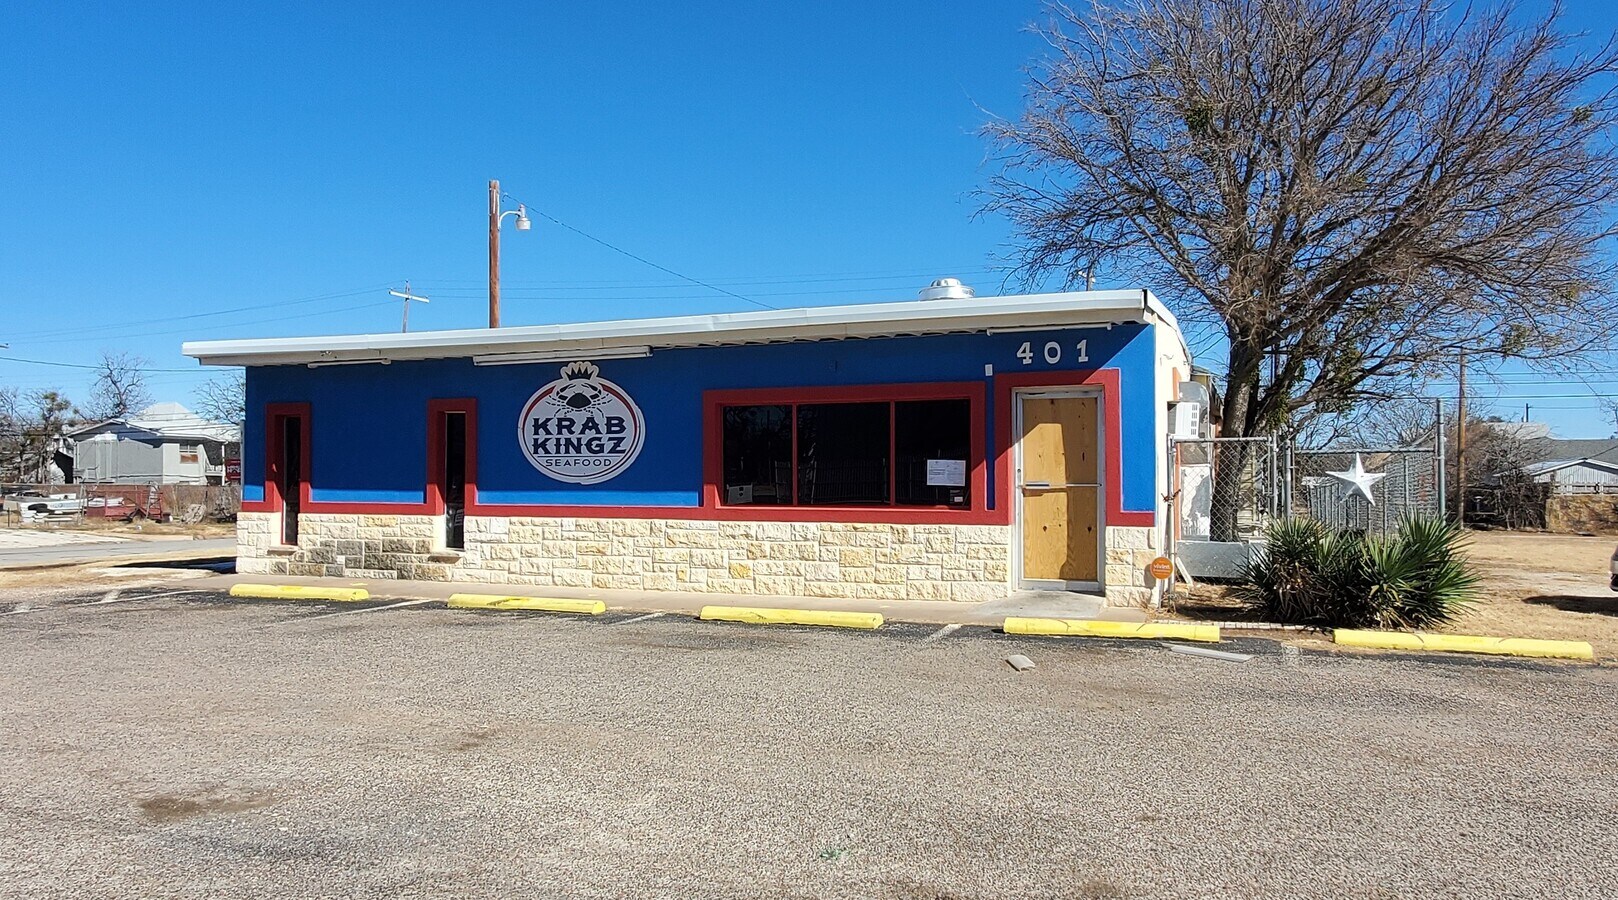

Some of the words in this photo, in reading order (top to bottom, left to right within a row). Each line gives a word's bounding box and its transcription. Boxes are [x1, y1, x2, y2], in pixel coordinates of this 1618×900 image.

[1016, 339, 1089, 365] 401
[532, 416, 626, 436] KRAB
[532, 436, 626, 455] KINGZ
[545, 458, 612, 467] SEAFOOD
